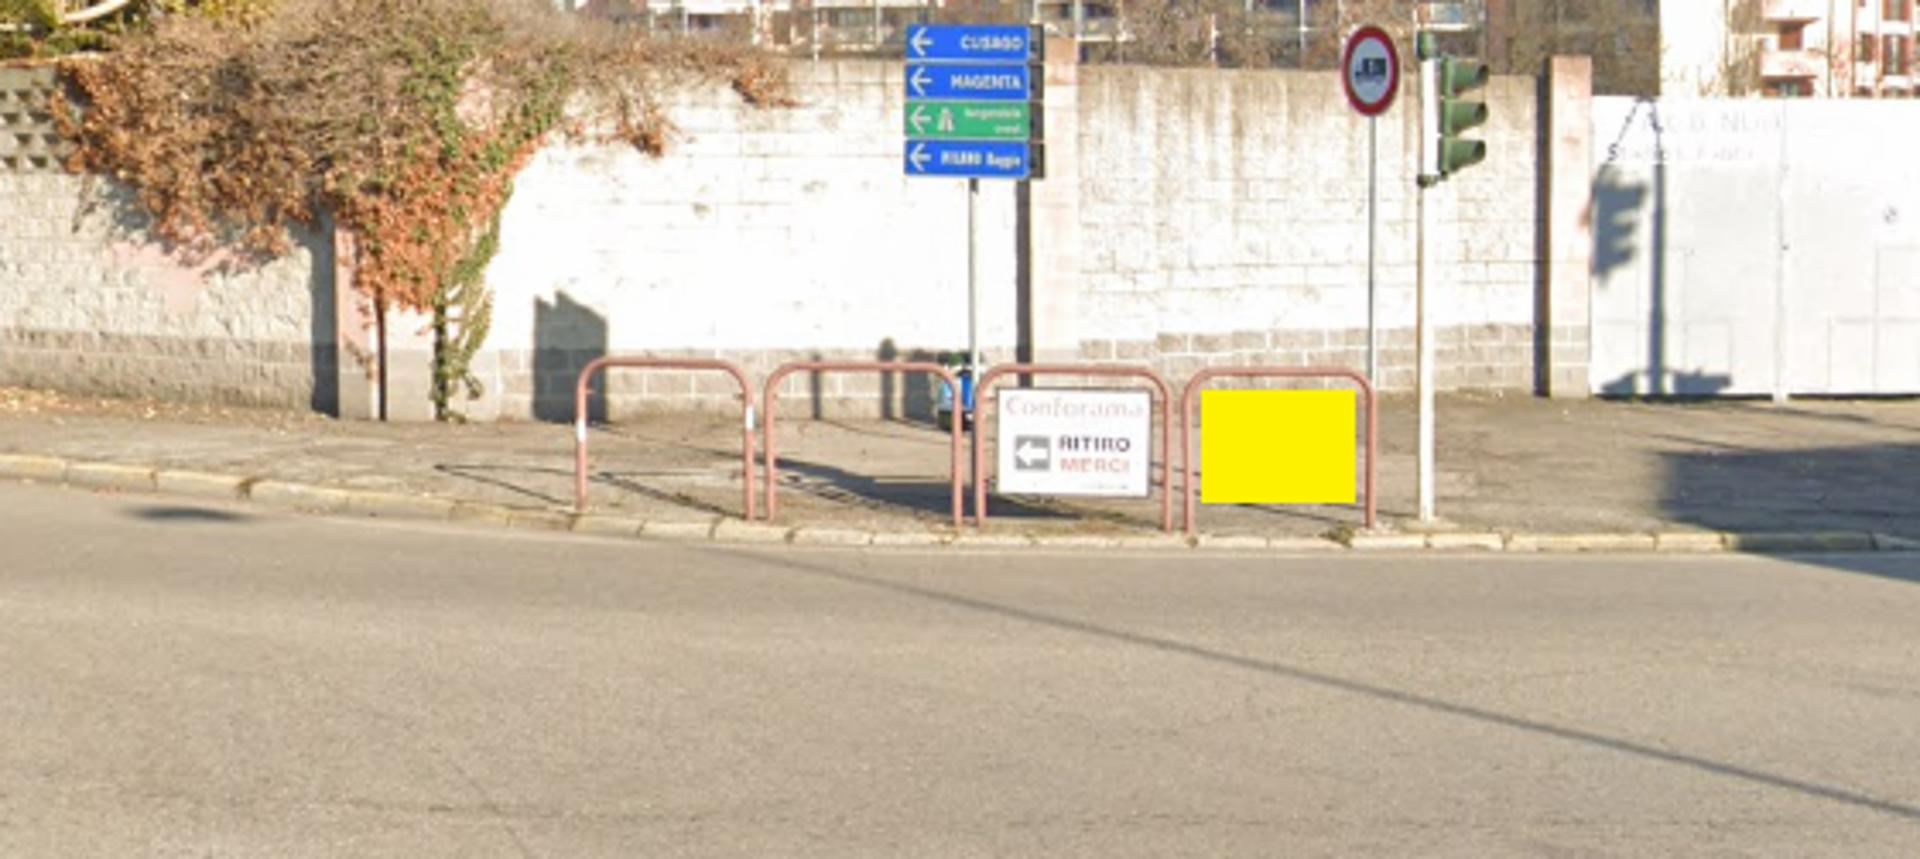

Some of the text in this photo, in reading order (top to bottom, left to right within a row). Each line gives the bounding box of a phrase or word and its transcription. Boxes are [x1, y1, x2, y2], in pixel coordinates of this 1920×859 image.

[950, 74, 1021, 90] MAGENTA
[1006, 395, 1145, 418] Conforama
[1059, 435, 1131, 452] RITIRO
[1060, 458, 1130, 473] MERCI
